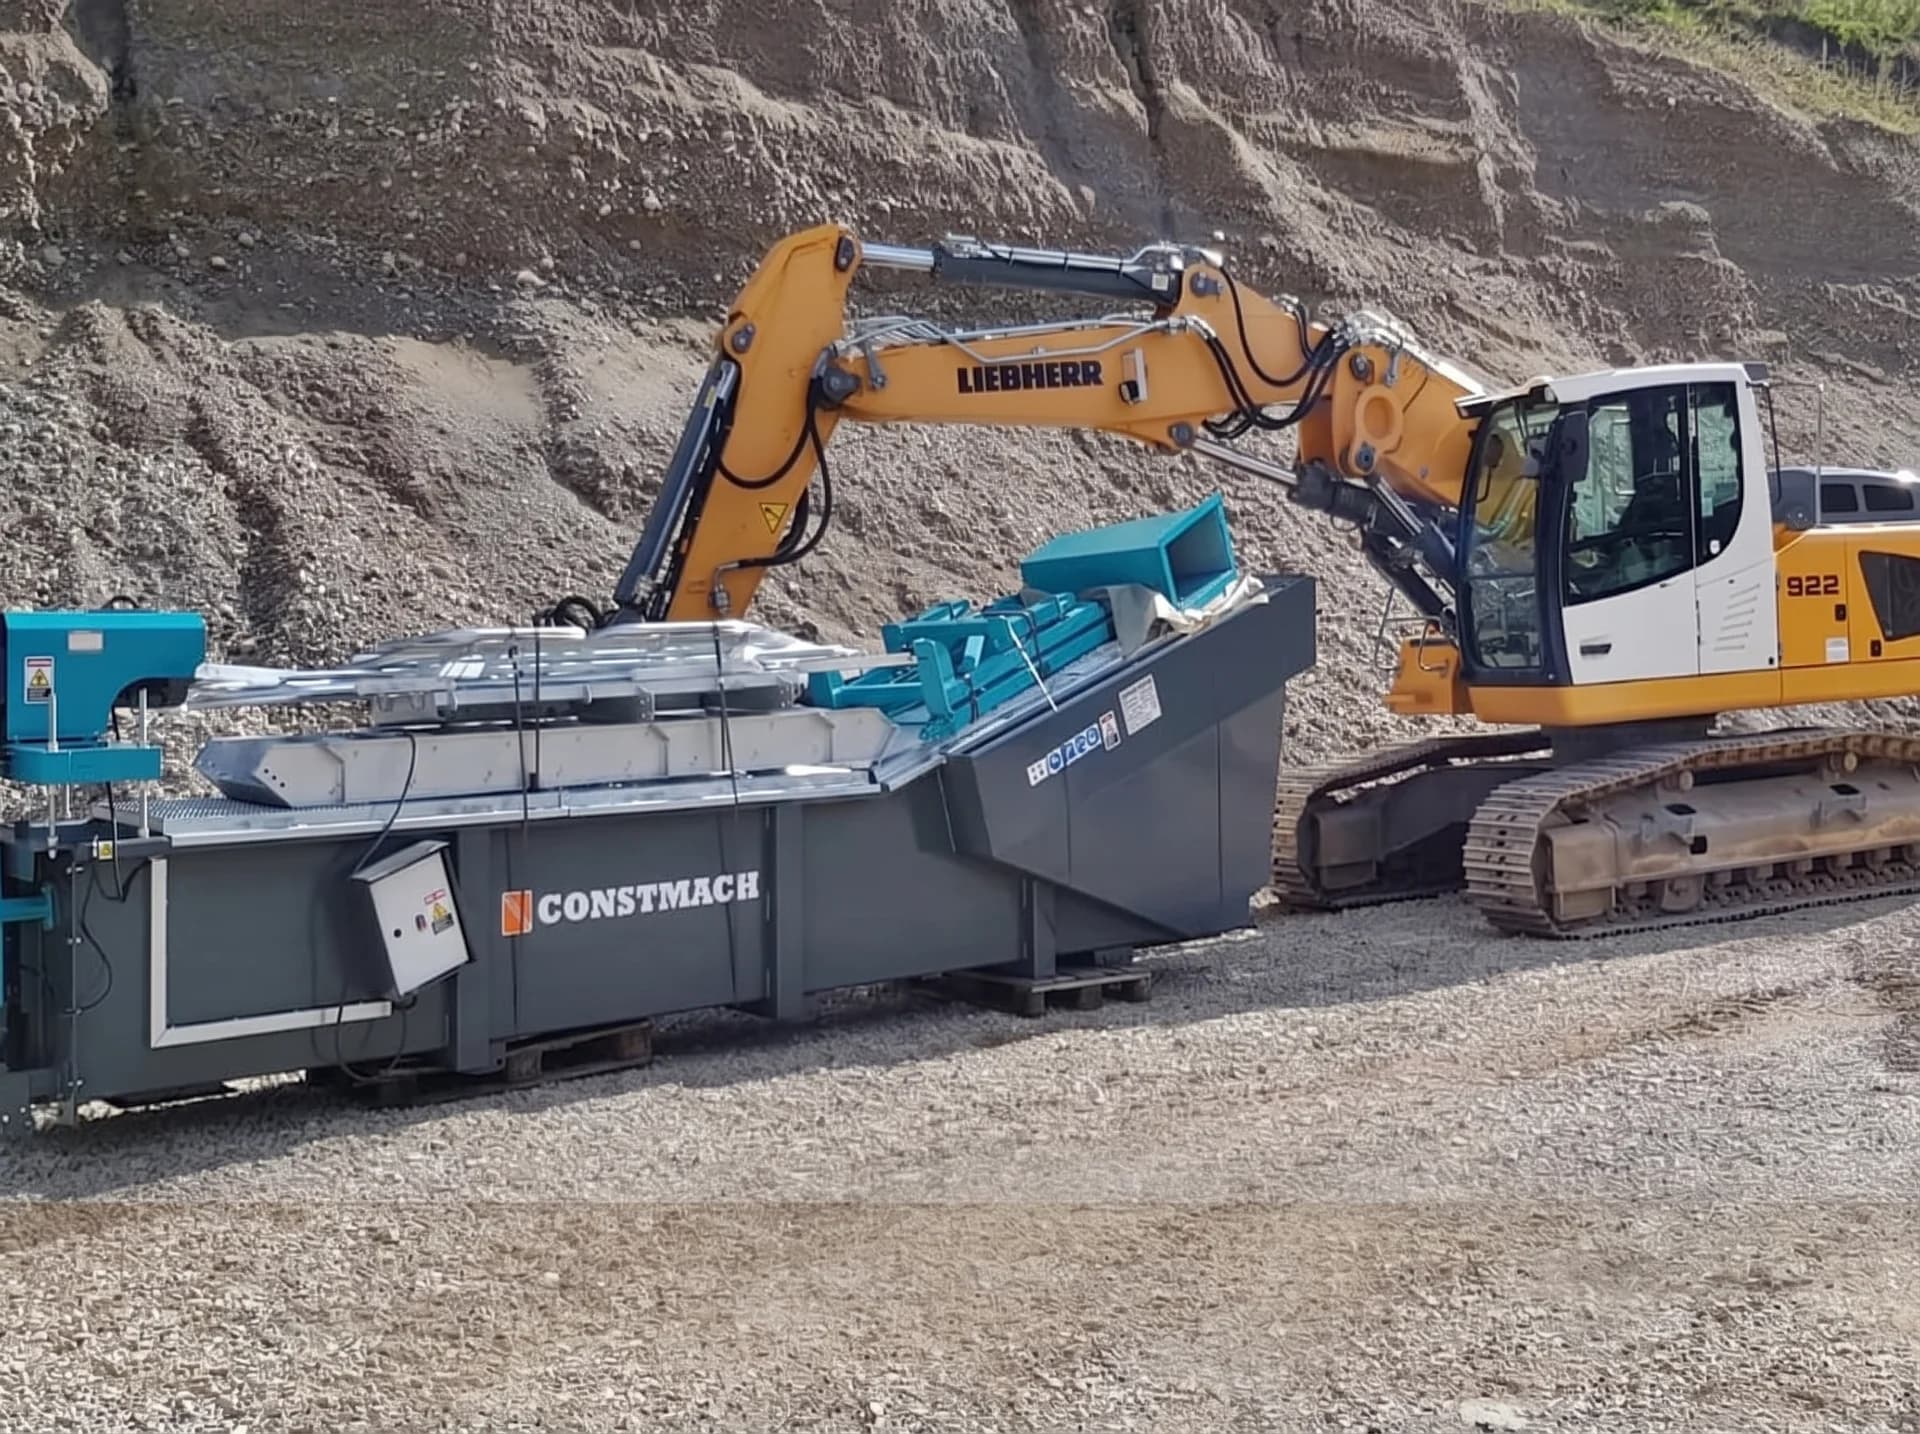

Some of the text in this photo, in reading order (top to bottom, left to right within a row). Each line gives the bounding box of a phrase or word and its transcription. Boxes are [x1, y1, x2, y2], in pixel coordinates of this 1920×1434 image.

[957, 361, 1104, 394] LIEBHERR
[1787, 575, 1839, 597] 922
[538, 871, 760, 924] CONSTMACH
